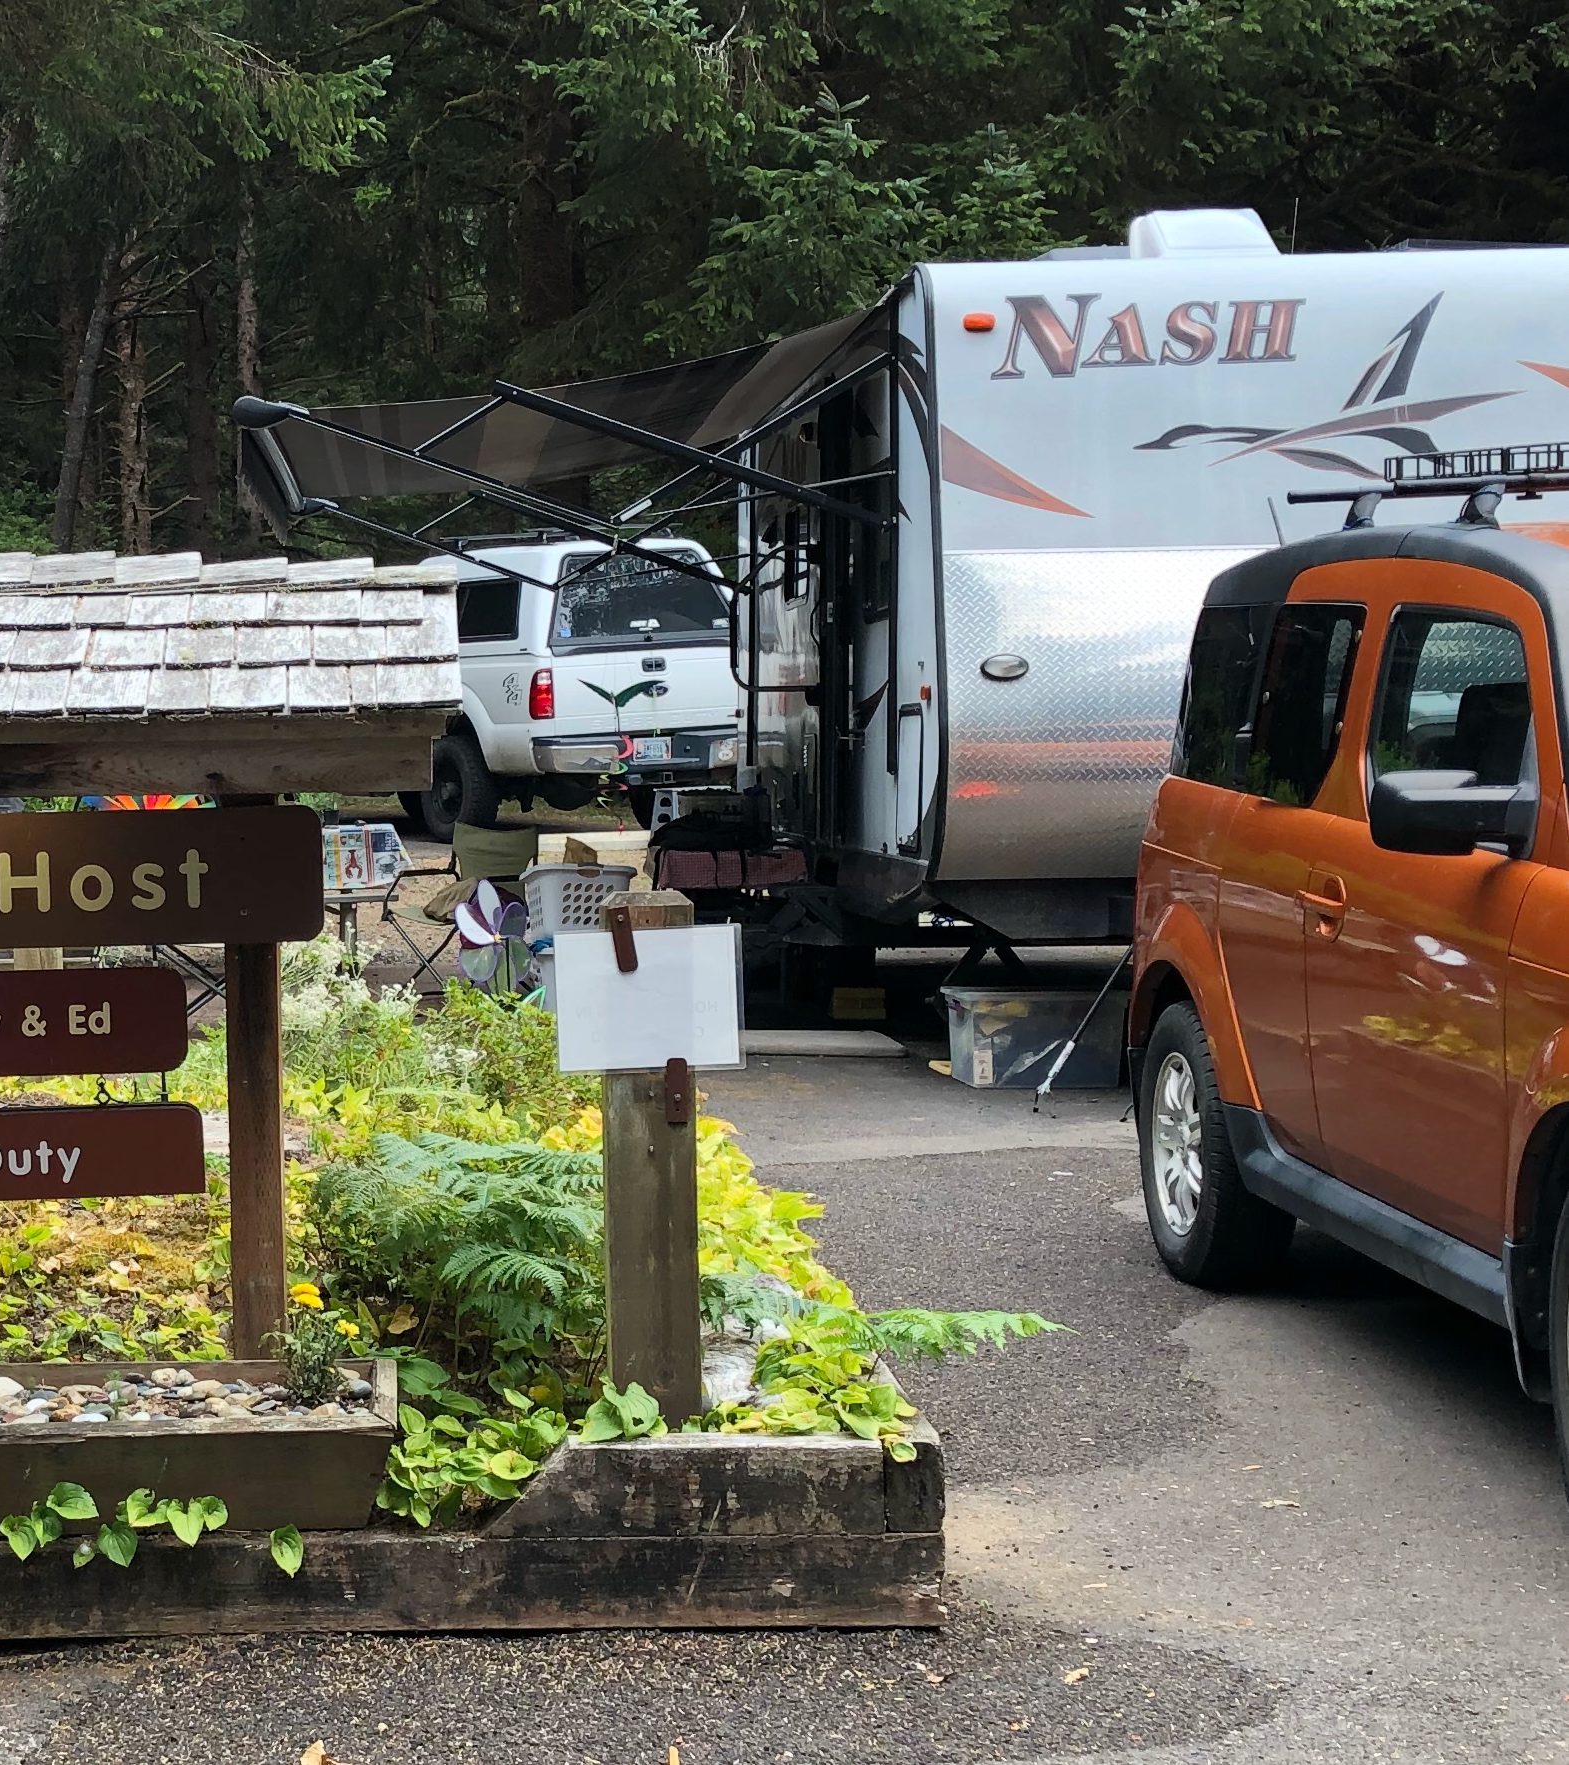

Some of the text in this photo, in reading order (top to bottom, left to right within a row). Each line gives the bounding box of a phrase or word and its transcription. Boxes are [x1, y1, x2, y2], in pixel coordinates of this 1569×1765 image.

[991, 293, 1306, 379] NASH
[21, 1005, 47, 1037] &
[68, 1002, 110, 1035] Ed
